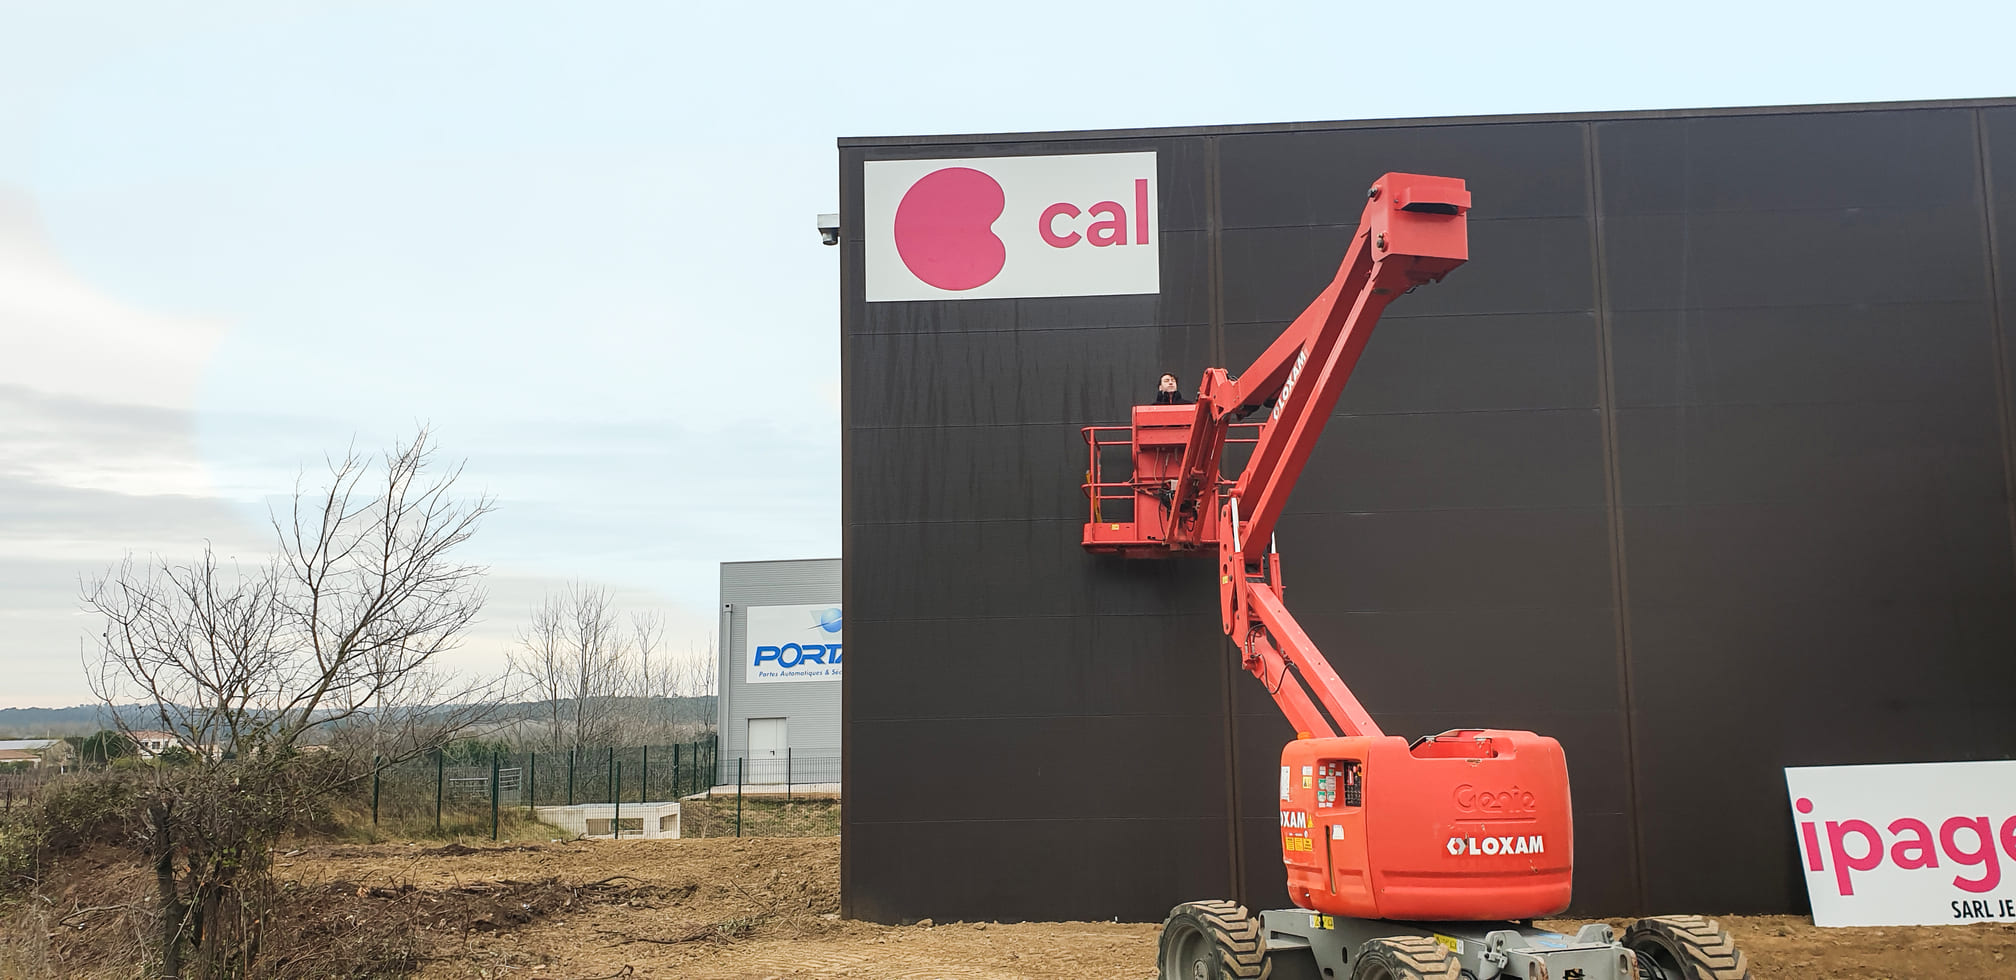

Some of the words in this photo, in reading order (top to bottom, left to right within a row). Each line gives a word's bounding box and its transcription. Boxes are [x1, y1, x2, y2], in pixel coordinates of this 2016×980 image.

[1038, 179, 1149, 248] cal
[1277, 351, 1306, 410] LOXAM
[1453, 784, 1536, 813] Genie
[1469, 836, 1544, 855] LOXAM
[1951, 900, 1994, 918] SARL
[1999, 899, 2016, 917] JE
